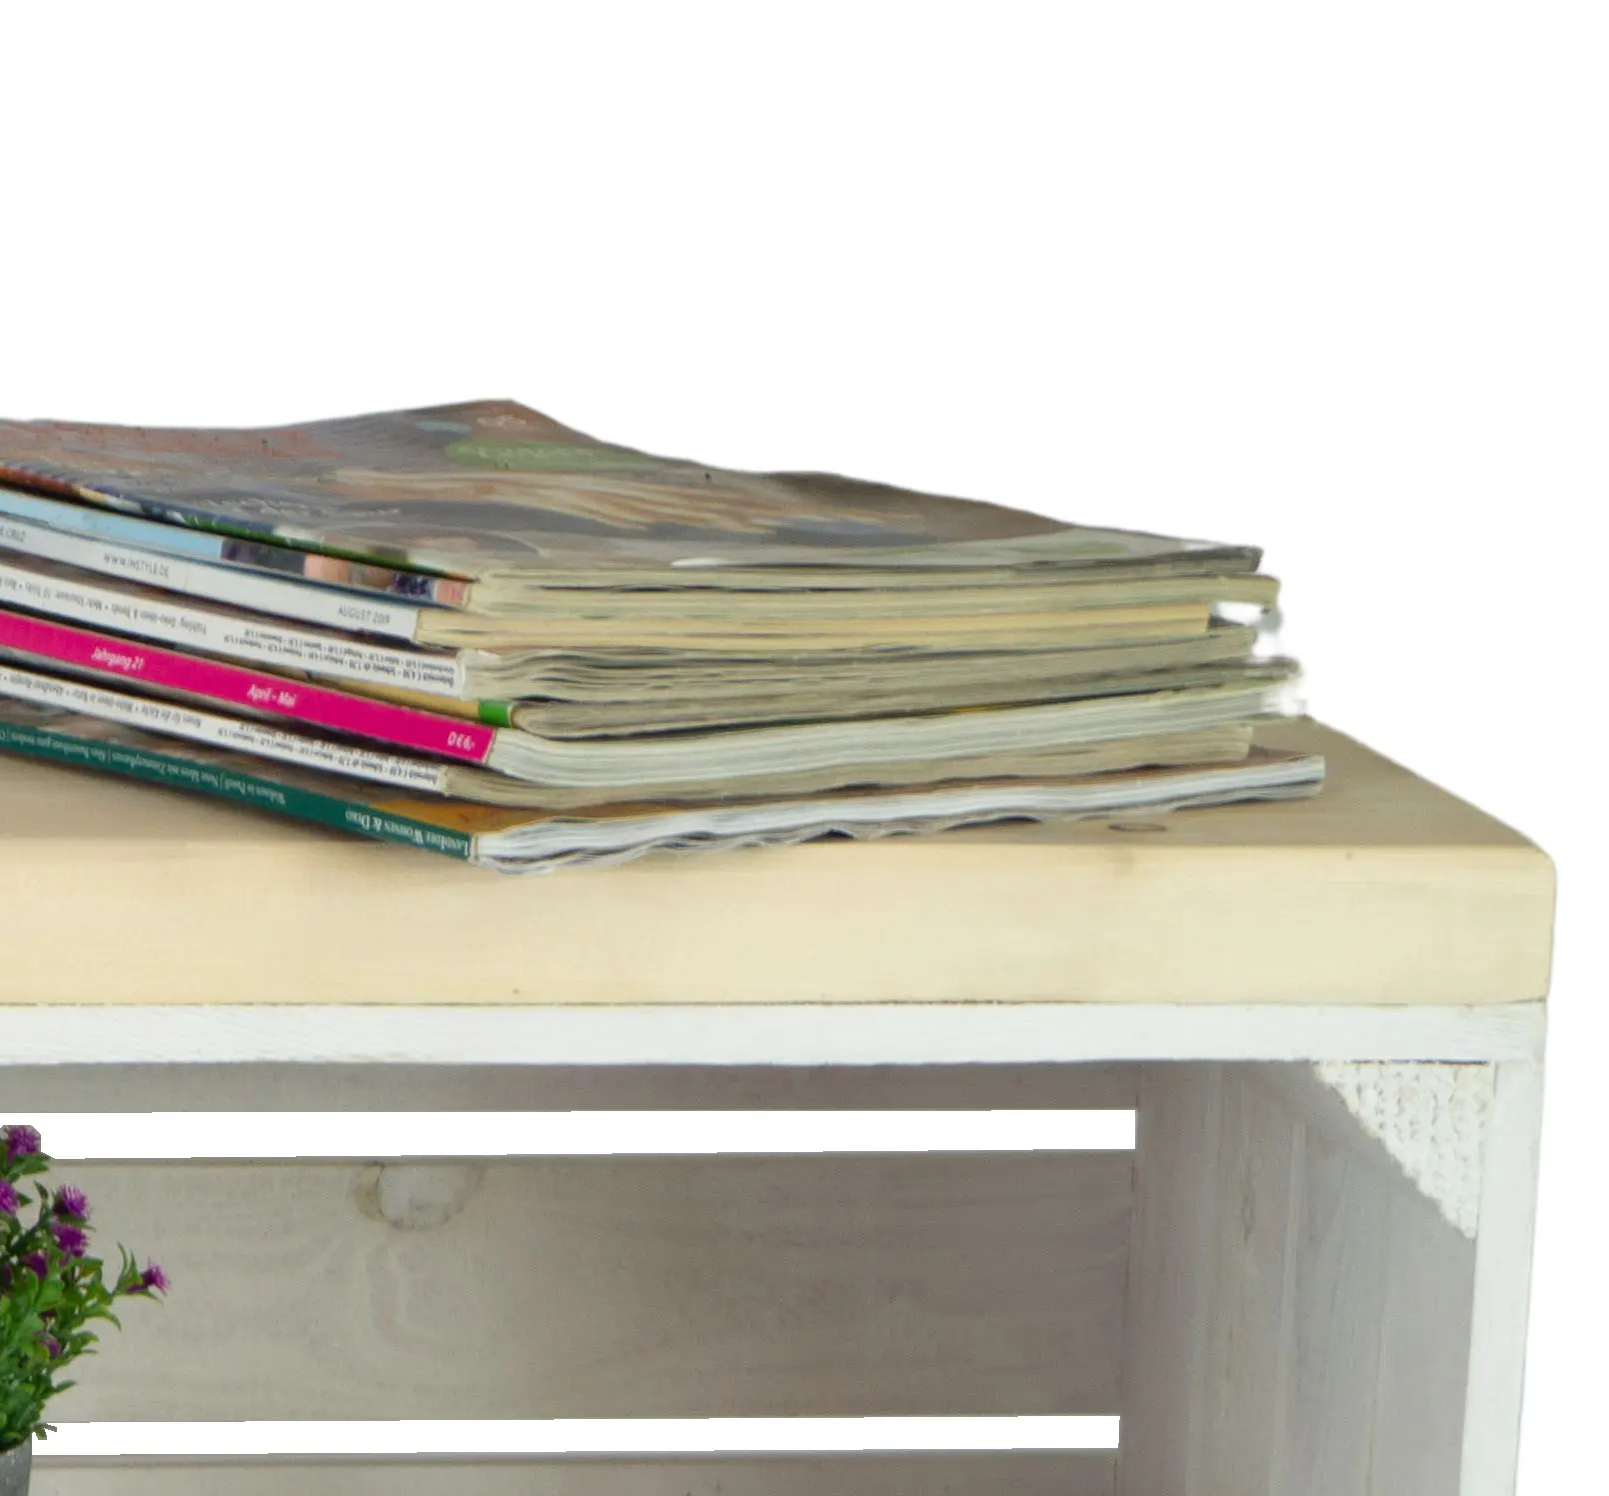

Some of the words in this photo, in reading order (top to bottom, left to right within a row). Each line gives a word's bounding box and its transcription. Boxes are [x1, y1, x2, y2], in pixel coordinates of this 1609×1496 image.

[338, 604, 371, 623] AUGUST
[91, 646, 130, 670] Jahrgang
[247, 683, 270, 704] April
[277, 691, 297, 708] Mai
[372, 817, 382, 832] &
